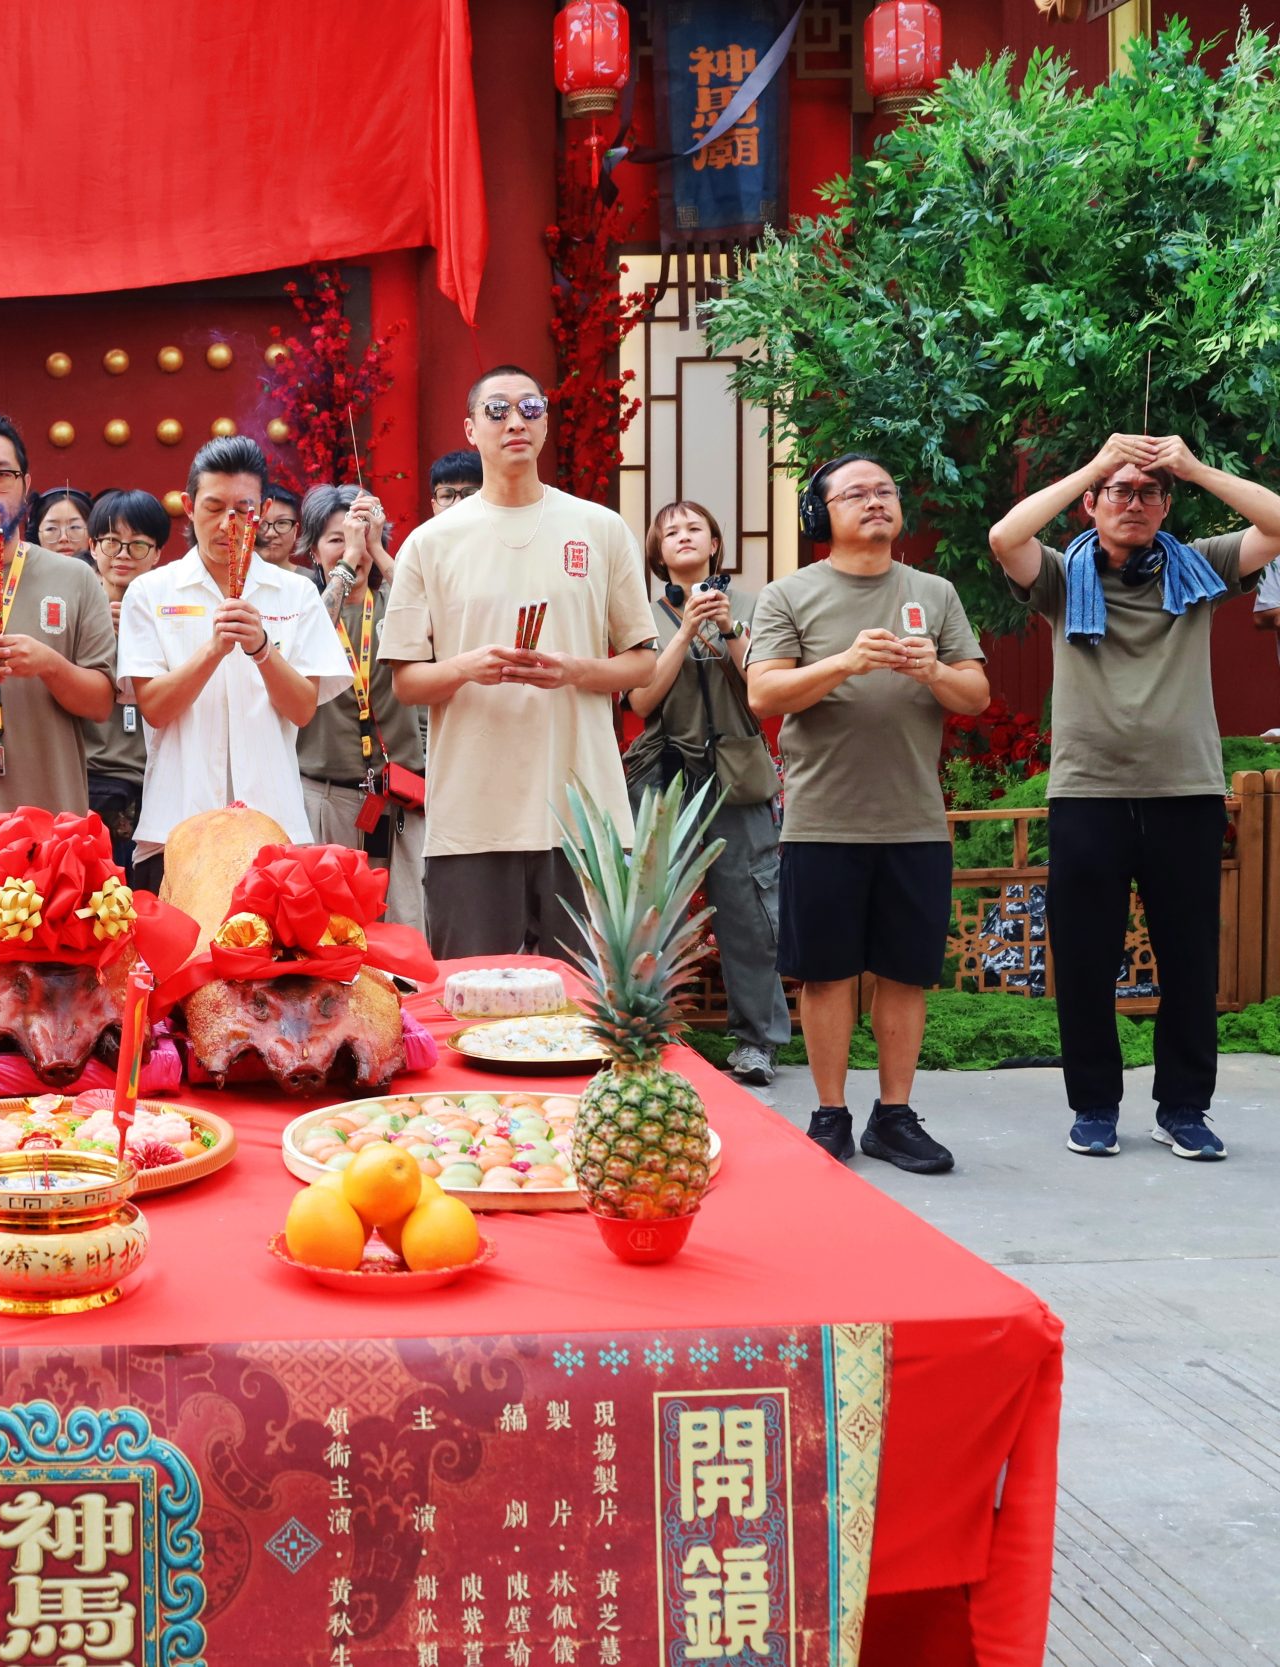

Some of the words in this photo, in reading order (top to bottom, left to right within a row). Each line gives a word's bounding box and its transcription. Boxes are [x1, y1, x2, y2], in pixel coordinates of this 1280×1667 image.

[689, 44, 760, 171] 神馬廟
[679, 1409, 770, 1658] 開鏡
